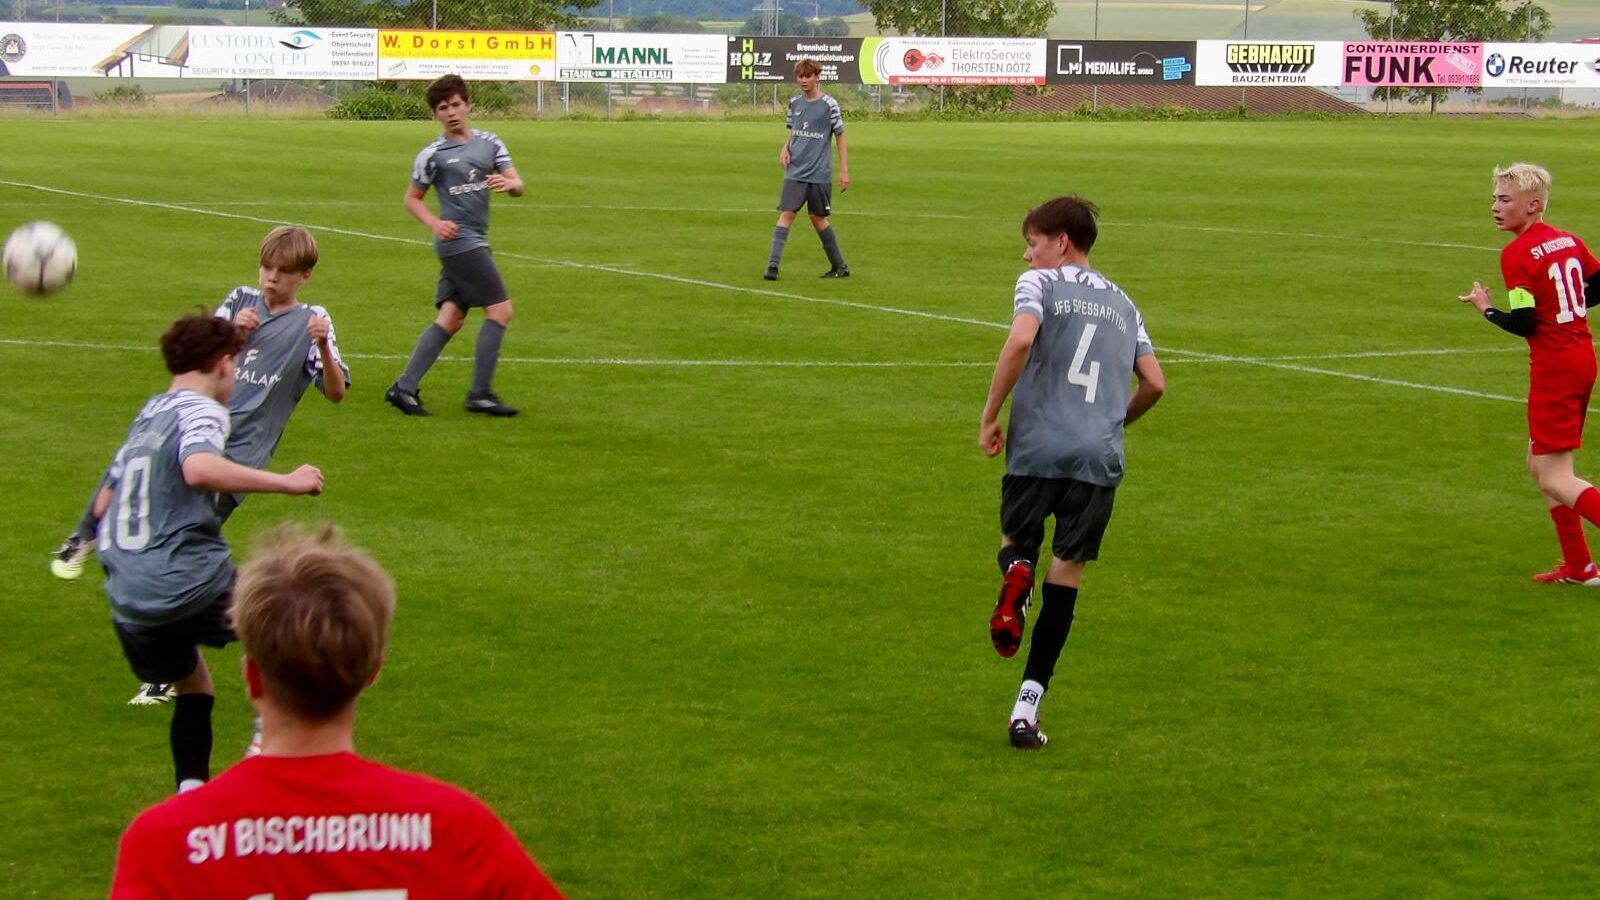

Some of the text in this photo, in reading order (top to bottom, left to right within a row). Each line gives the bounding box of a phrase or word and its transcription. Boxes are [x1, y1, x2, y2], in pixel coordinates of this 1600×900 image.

[191, 33, 275, 49] CUSTODIA
[350, 32, 374, 40] Security
[383, 35, 552, 50] W. Dorst GmbH
[331, 41, 371, 49] Objektschutz
[797, 43, 842, 52] Brennholz und
[1346, 44, 1480, 54] CONTAINERDIENST
[234, 52, 312, 66] CONCEPT
[595, 47, 673, 65] MANNL
[730, 52, 772, 66] HOLZ
[786, 53, 855, 63] Forstdienstleistungen
[952, 49, 1032, 61] ElektroService
[1226, 44, 1315, 66] GEBHARDT
[239, 68, 276, 76] SERVICES
[952, 60, 1031, 73] THORSTEN GÖTZ
[1345, 56, 1436, 83] FUNK
[1508, 56, 1578, 74] Reuter
[611, 70, 673, 79] METALLBAU
[1232, 75, 1306, 83] BAUZENTRUM
[1531, 245, 1544, 260] SV
[1548, 257, 1587, 324] 10
[1054, 300, 1071, 316] JFG
[1067, 323, 1100, 404] 4
[186, 812, 433, 864] SV BISCHBRUNN
